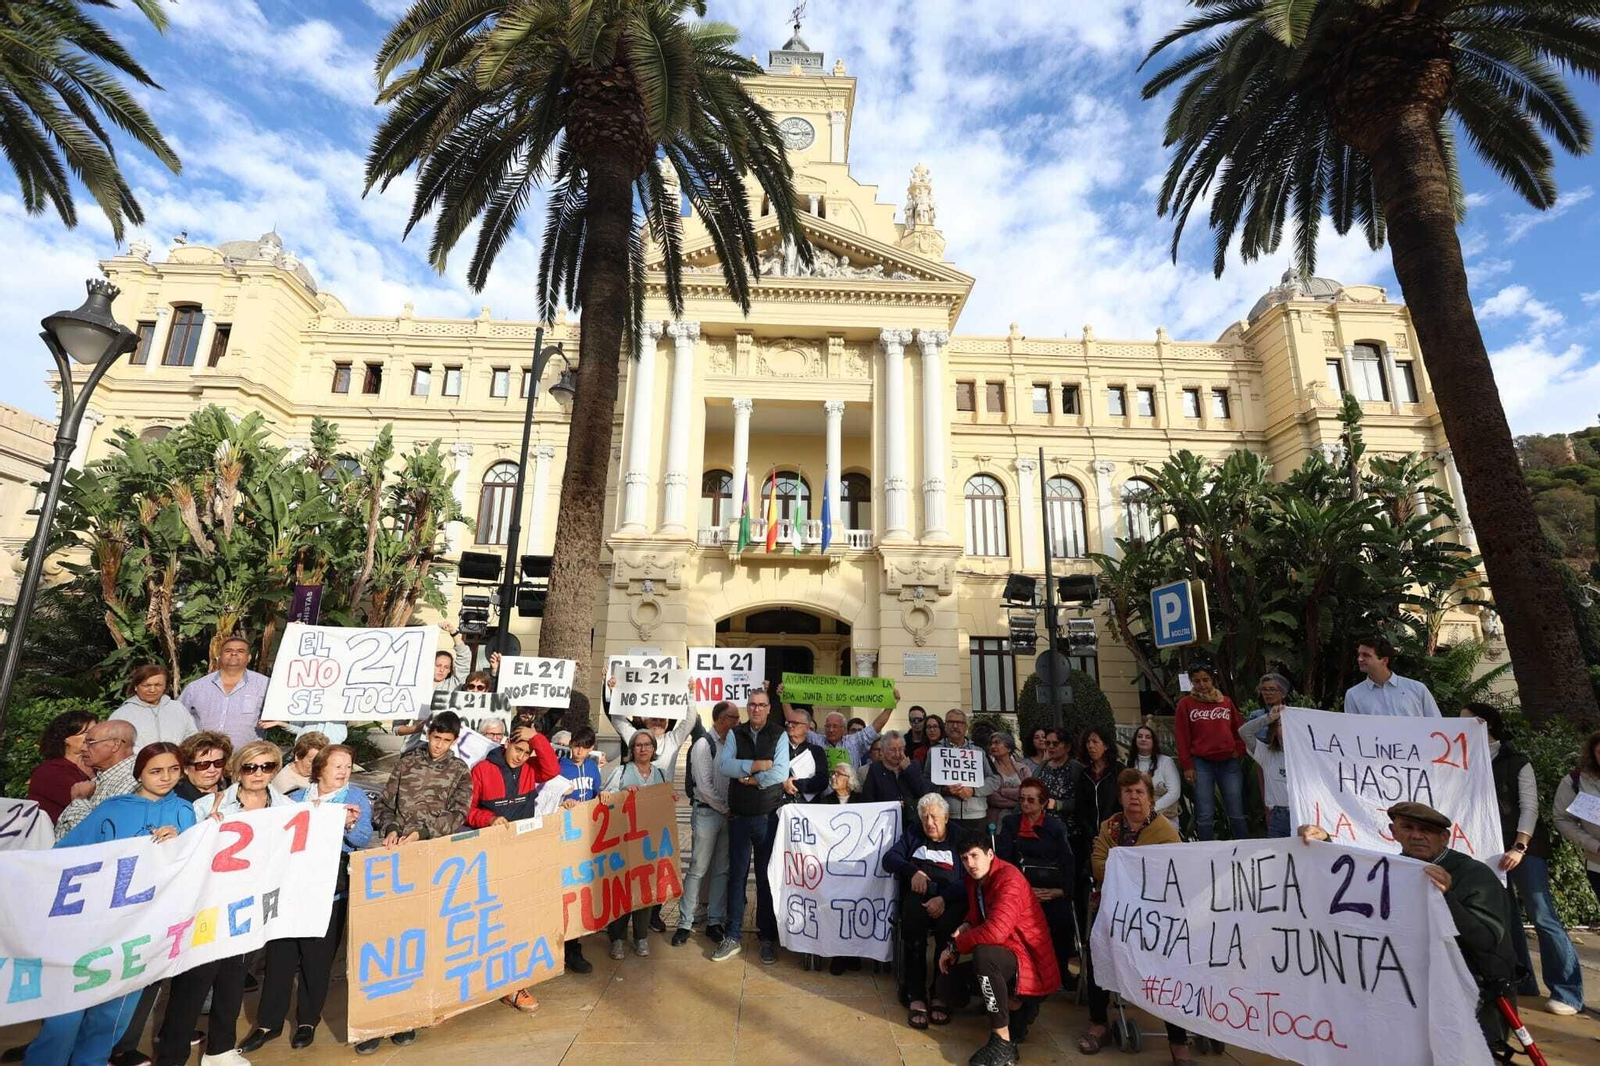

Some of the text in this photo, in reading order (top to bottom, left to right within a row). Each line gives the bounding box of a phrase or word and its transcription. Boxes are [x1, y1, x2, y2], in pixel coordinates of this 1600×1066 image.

[1158, 592, 1182, 639] P
[287, 659, 341, 688] NO
[299, 630, 425, 687] EL 21
[514, 660, 566, 679] EL 21
[626, 671, 669, 684] EL 21
[697, 653, 753, 671] EL 21
[430, 690, 461, 710] EL
[464, 693, 487, 708] 21
[620, 693, 637, 706] NO
[662, 692, 689, 706] TOCA
[696, 677, 724, 701] NO
[725, 684, 741, 700] SE
[785, 675, 892, 688] AYUNTAMIENTO MARGINA LA
[803, 692, 823, 702] JUNTA
[850, 694, 884, 703] CAMINOS
[287, 687, 415, 716] SE TOCA
[941, 749, 975, 759] EL 21
[944, 759, 977, 770] NO SE
[1308, 724, 1345, 757] LA
[1430, 732, 1469, 771] 21
[942, 770, 976, 782] TOCA
[1339, 762, 1434, 807] HASTA
[560, 790, 650, 853] L 21
[643, 827, 674, 861] LA
[790, 809, 899, 878] EL 21
[48, 810, 311, 918] EL 21
[783, 851, 824, 890] NO
[1141, 846, 1391, 920] LA LÍNEA 21
[364, 850, 499, 919] EL 21
[785, 894, 819, 941] SE
[0, 887, 281, 1004] O SE TOCA
[359, 903, 507, 985] NO SE
[1110, 902, 1418, 1009] HASTA LA JUNTA
[445, 936, 555, 1002] TOCA
